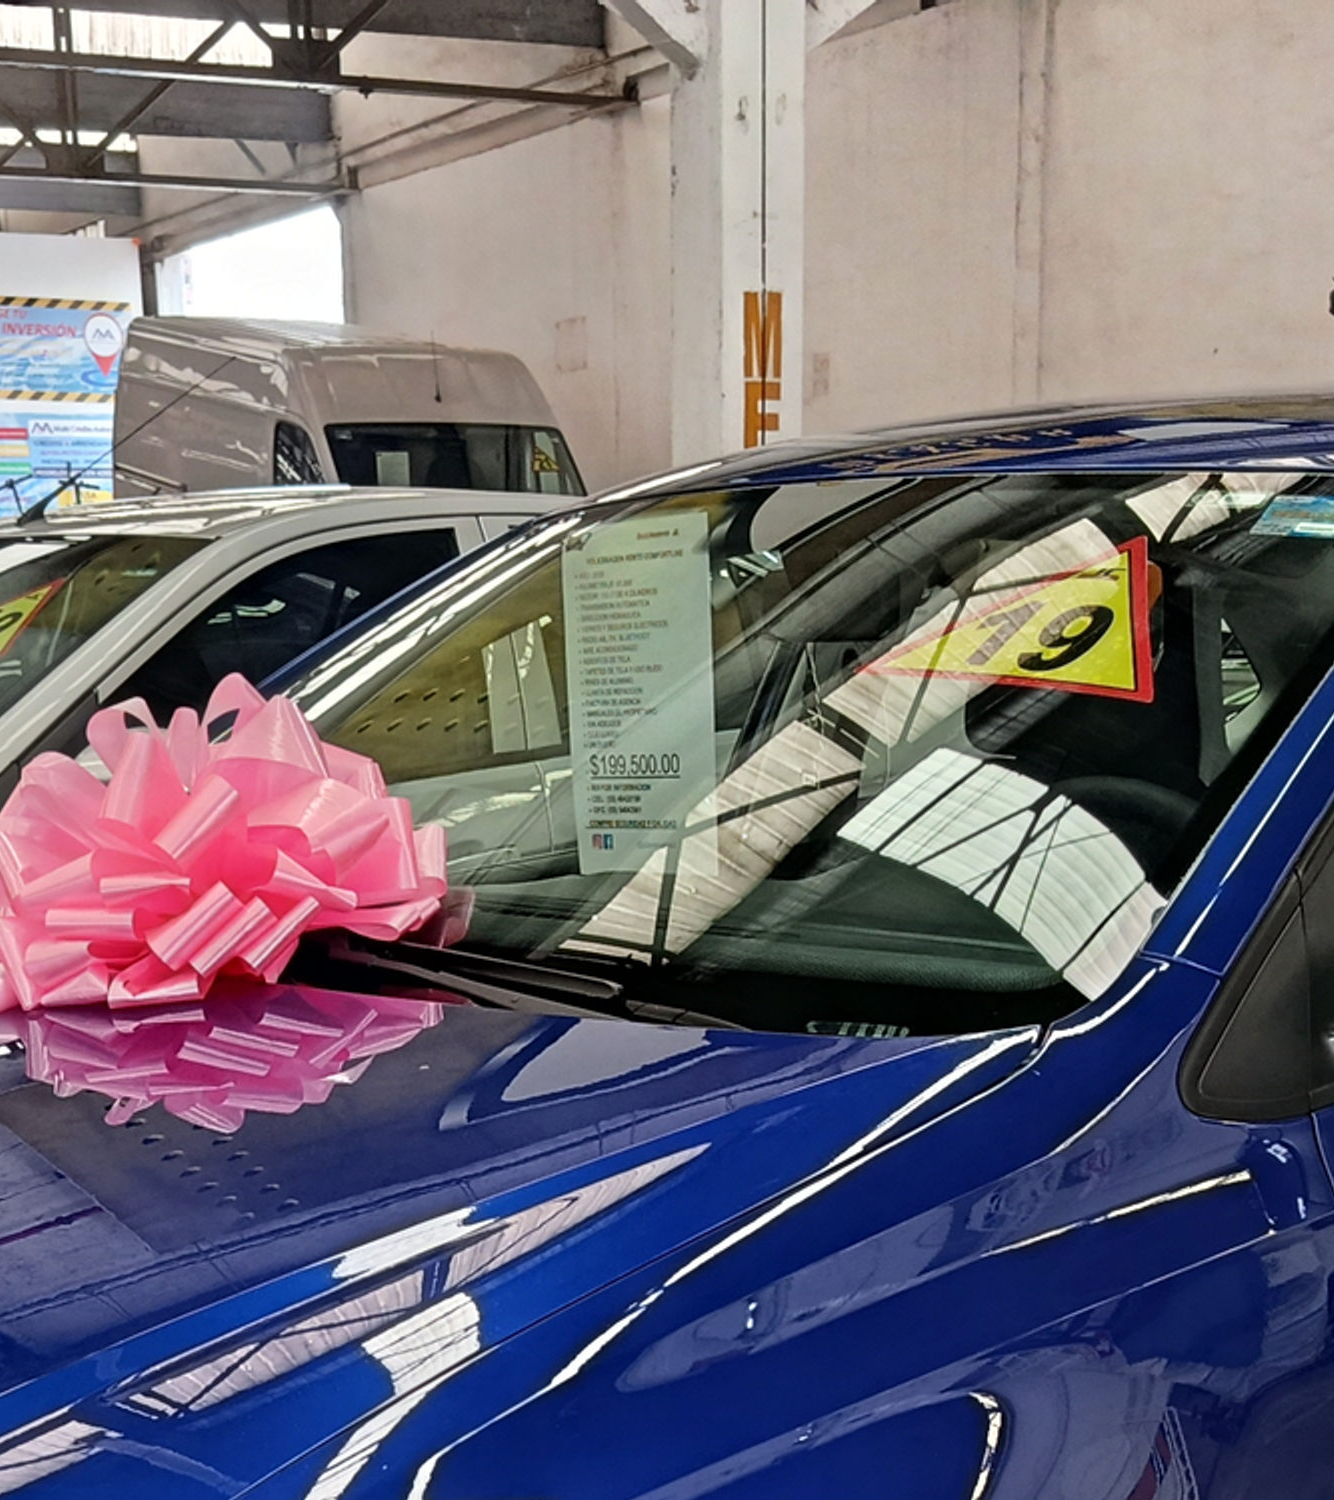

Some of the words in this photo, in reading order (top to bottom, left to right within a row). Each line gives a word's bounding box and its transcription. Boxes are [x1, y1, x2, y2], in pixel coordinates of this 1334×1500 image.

[13, 308, 29, 319] TU
[1, 321, 78, 338] INVERSIÓN
[588, 753, 681, 777] $199,500.00
